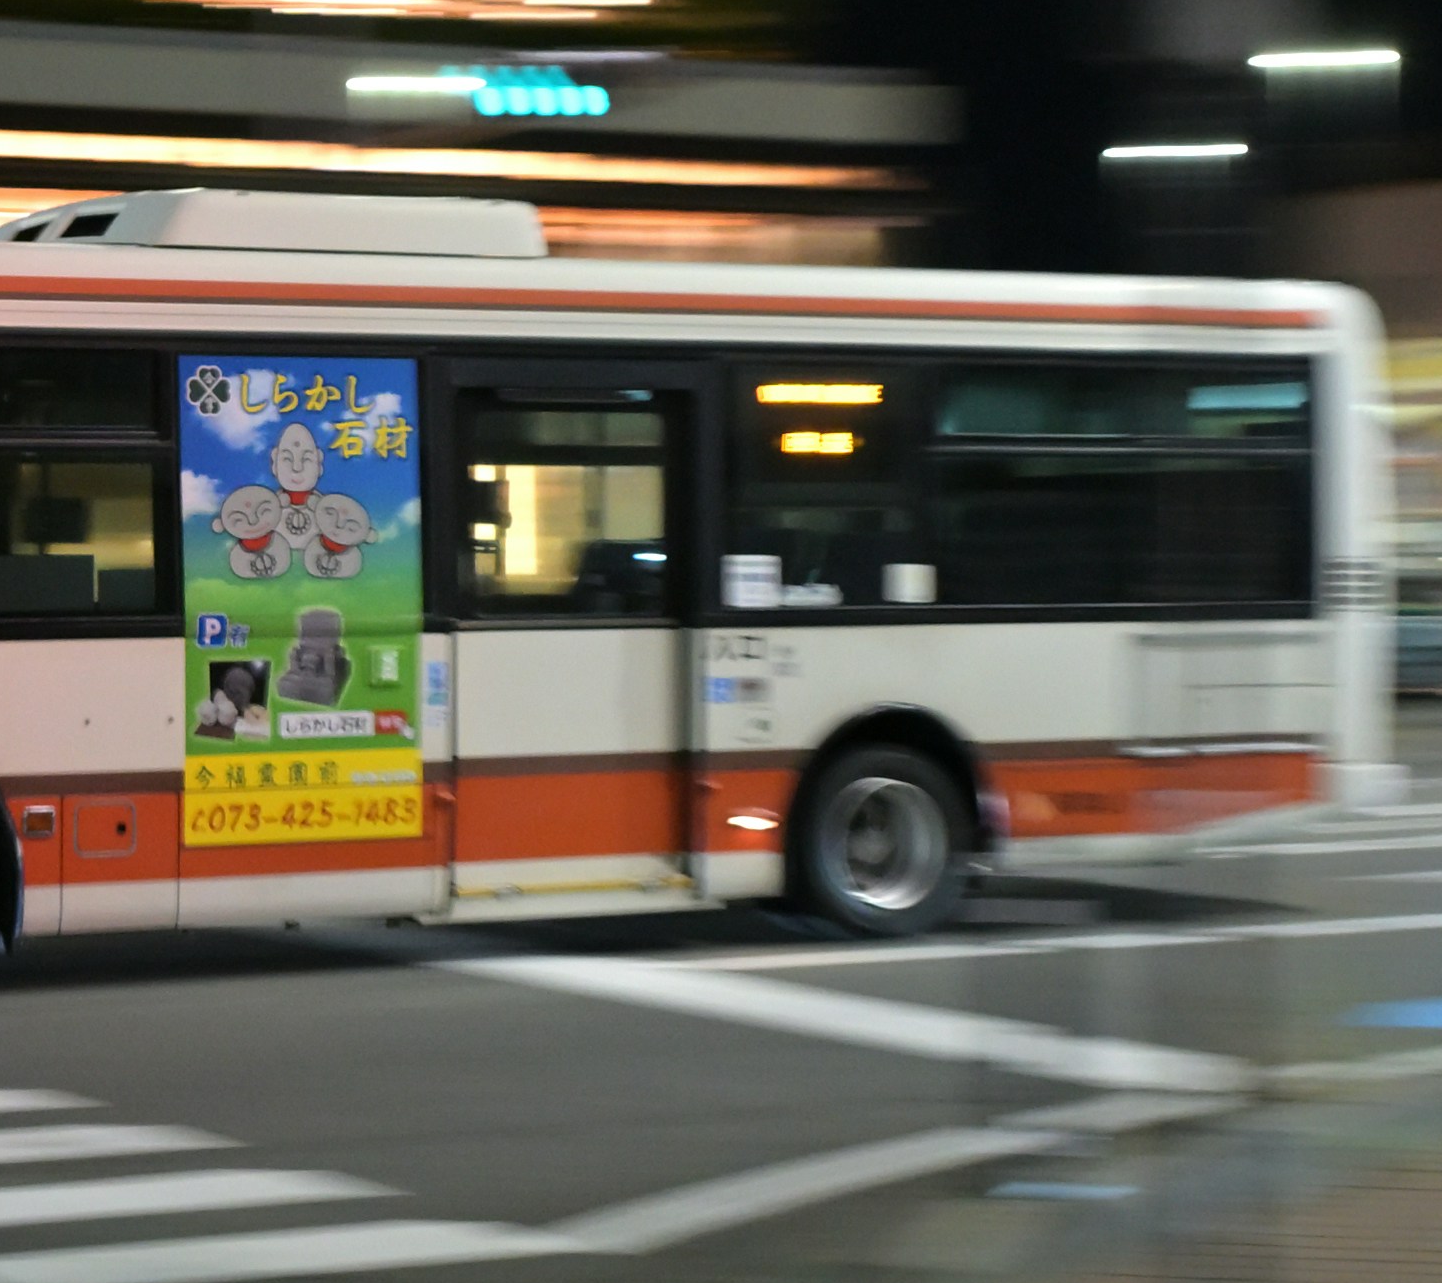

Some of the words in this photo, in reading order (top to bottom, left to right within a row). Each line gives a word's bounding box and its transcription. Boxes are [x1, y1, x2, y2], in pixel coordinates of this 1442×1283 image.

[240, 373, 376, 413] しらかし
[329, 417, 413, 459] 石材
